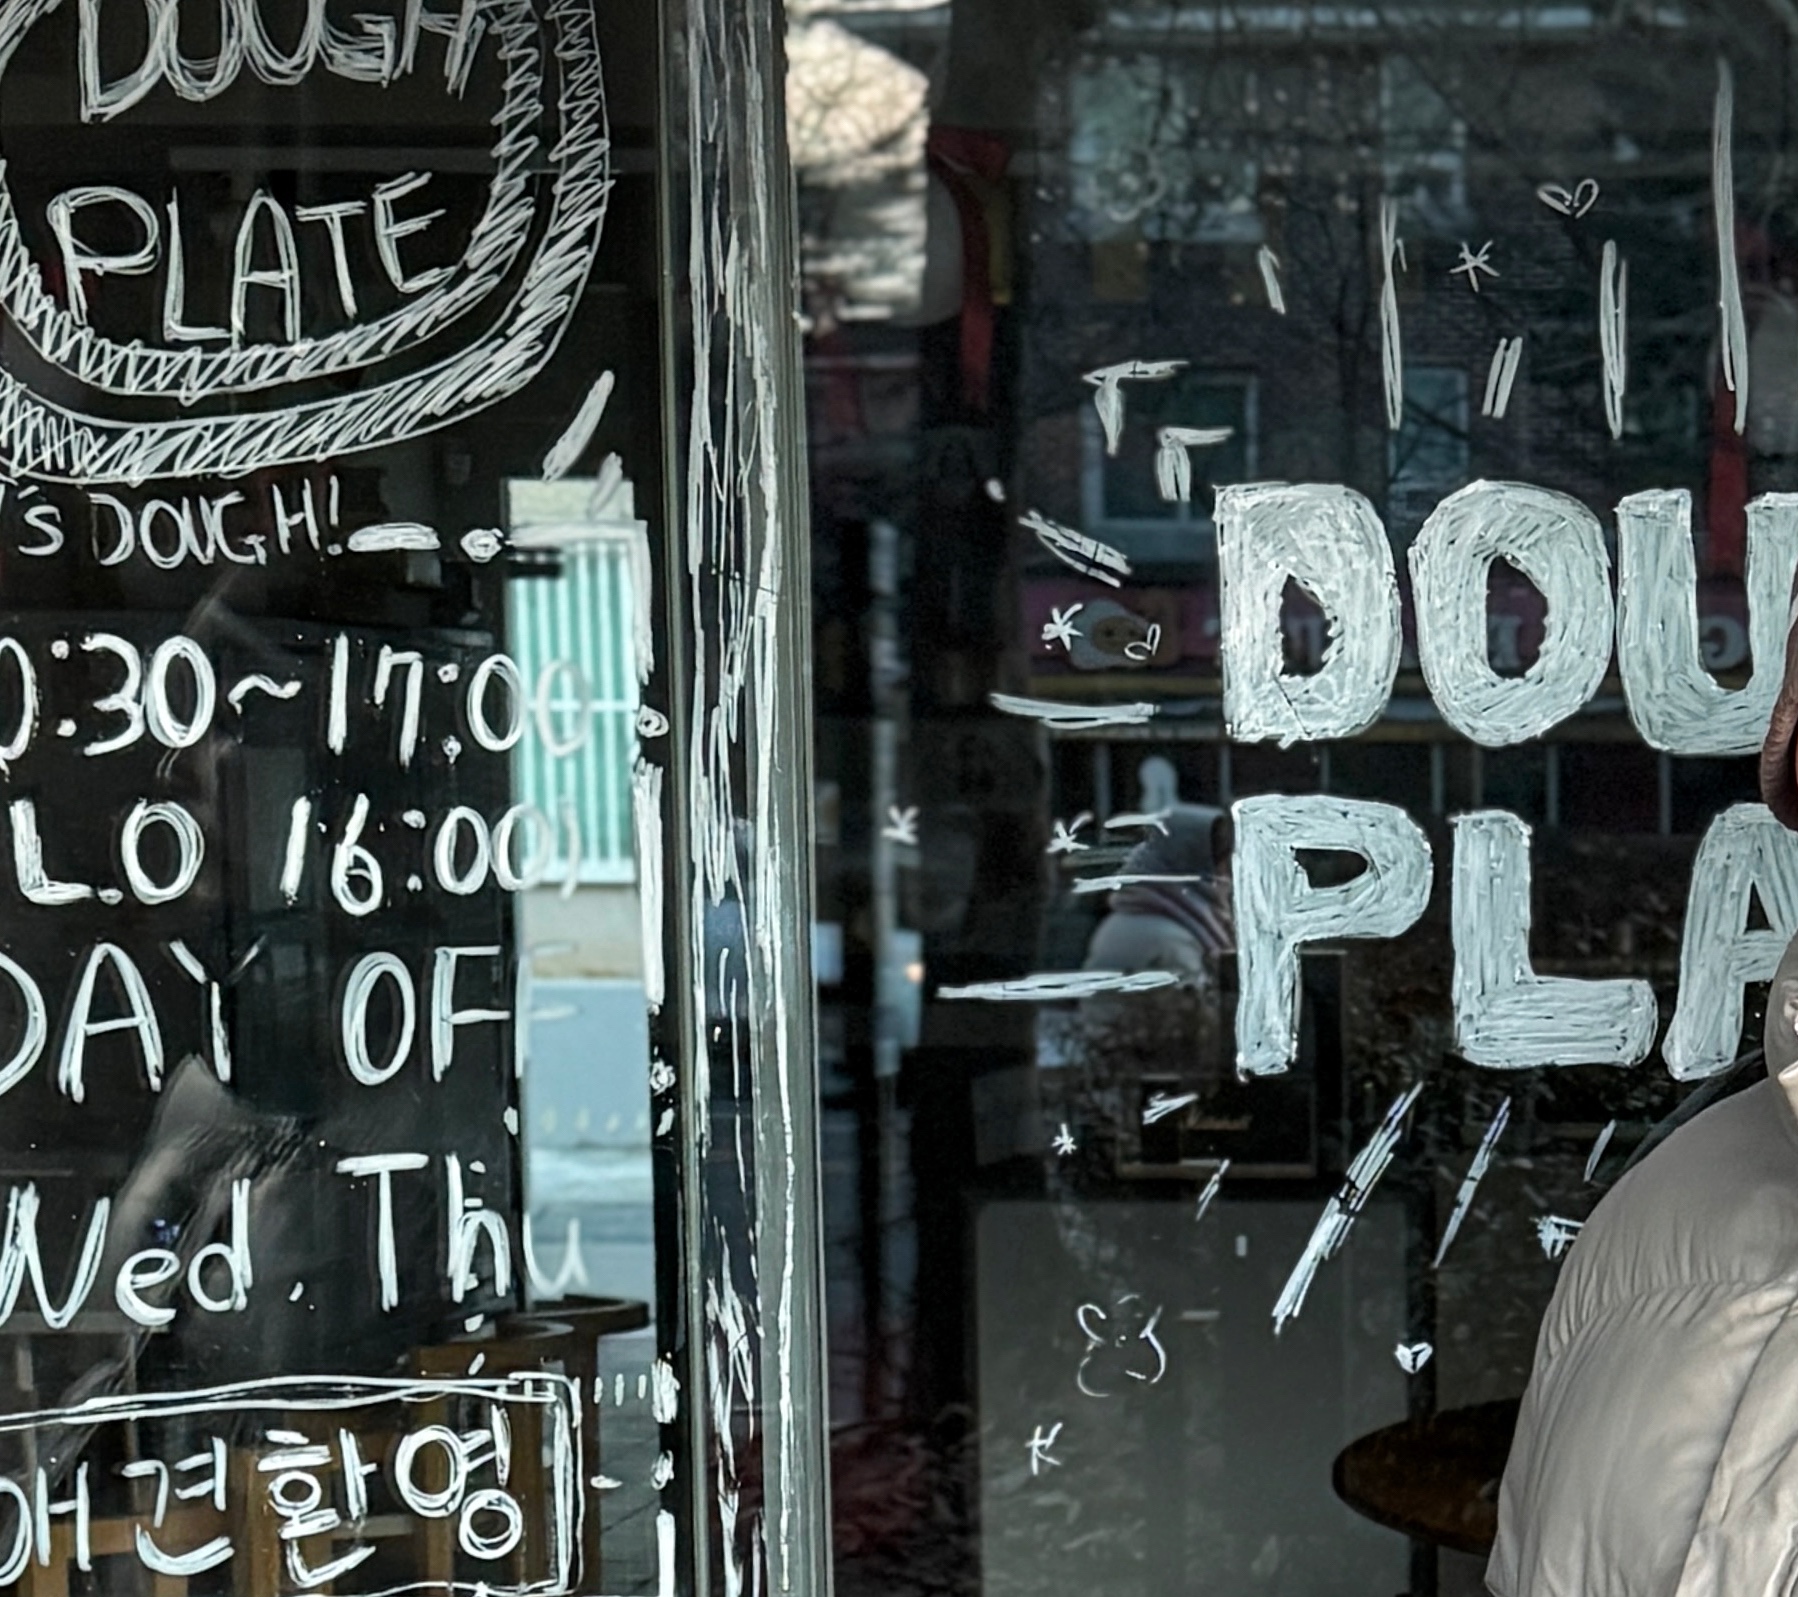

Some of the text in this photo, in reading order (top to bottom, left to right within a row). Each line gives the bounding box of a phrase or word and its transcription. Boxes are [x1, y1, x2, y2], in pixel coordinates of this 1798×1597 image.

[47, 172, 460, 348] PLATE
[89, 475, 343, 569] DOUGH!
[343, 941, 578, 1085] OFF
[336, 1153, 590, 1312] Thu
